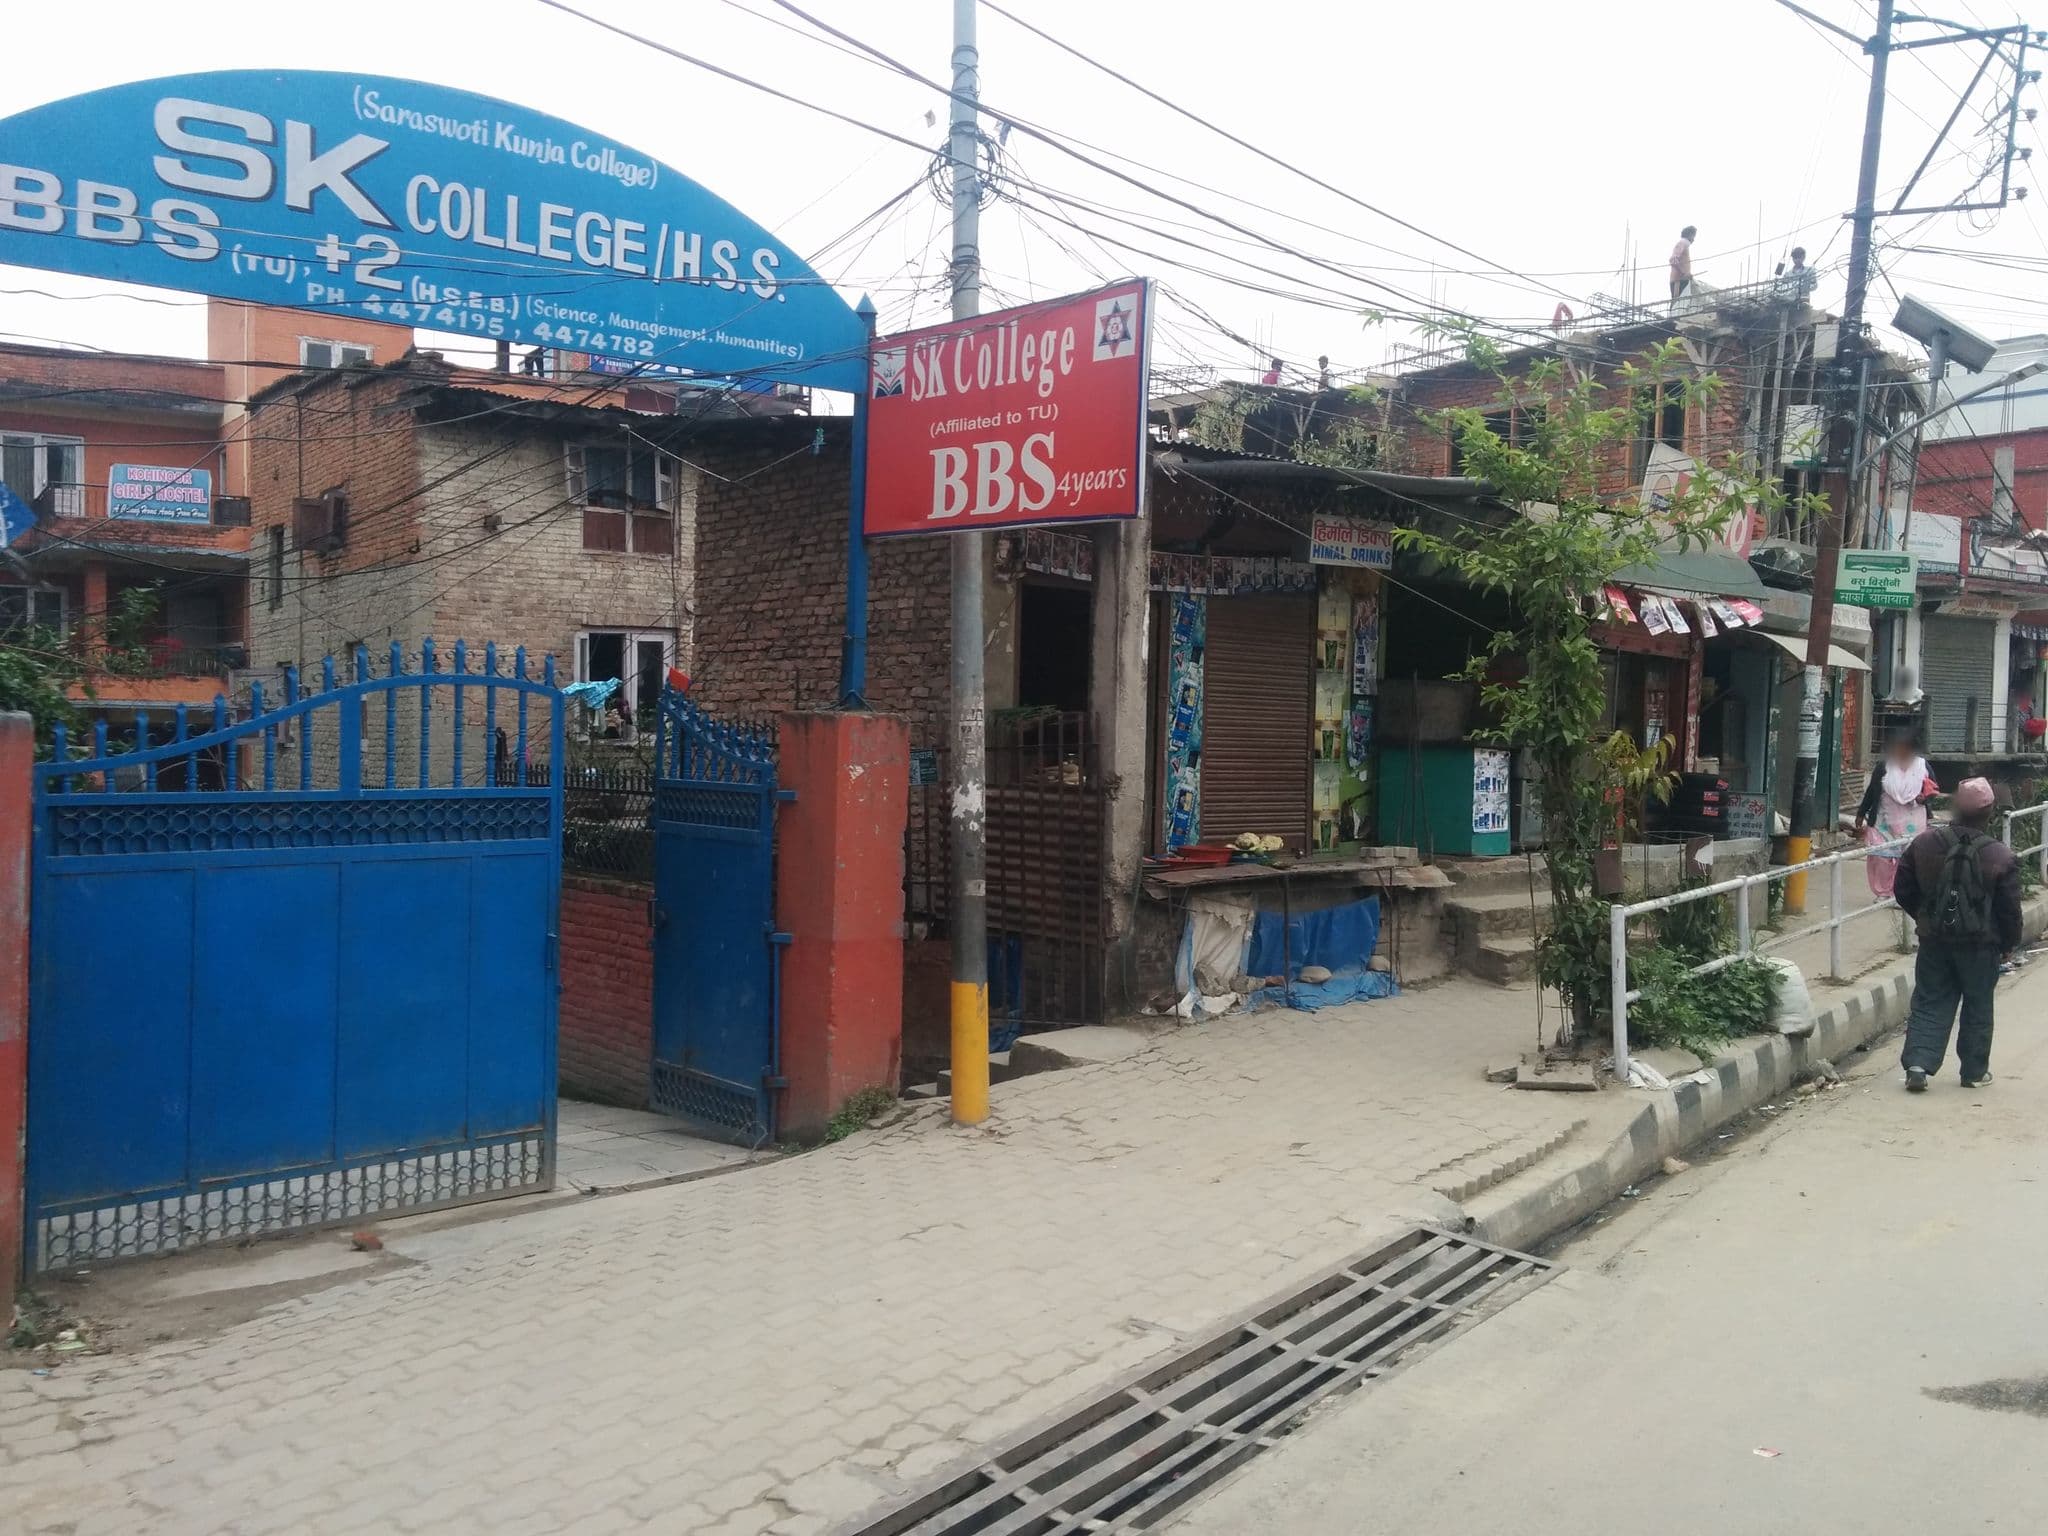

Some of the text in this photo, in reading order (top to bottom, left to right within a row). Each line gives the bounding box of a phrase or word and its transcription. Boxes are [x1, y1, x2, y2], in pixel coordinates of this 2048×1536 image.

[153, 97, 395, 228] SK
[354, 85, 657, 190] (Saraswoti Kunja College)
[0, 163, 222, 261] BBS
[315, 234, 403, 291] +2
[412, 275, 519, 320] (H.S.E.B.)
[716, 330, 804, 360] Humanities)
[533, 322, 655, 356] 4474782
[911, 320, 1075, 401] SK College
[930, 403, 1059, 438] (Affiliated to TU)
[113, 483, 207, 503] GIRLS HOSTEL
[128, 468, 192, 484] KOHINOOR
[928, 431, 1127, 519] BBS 4years
[1312, 544, 1391, 565] HIMAL DRINKS
